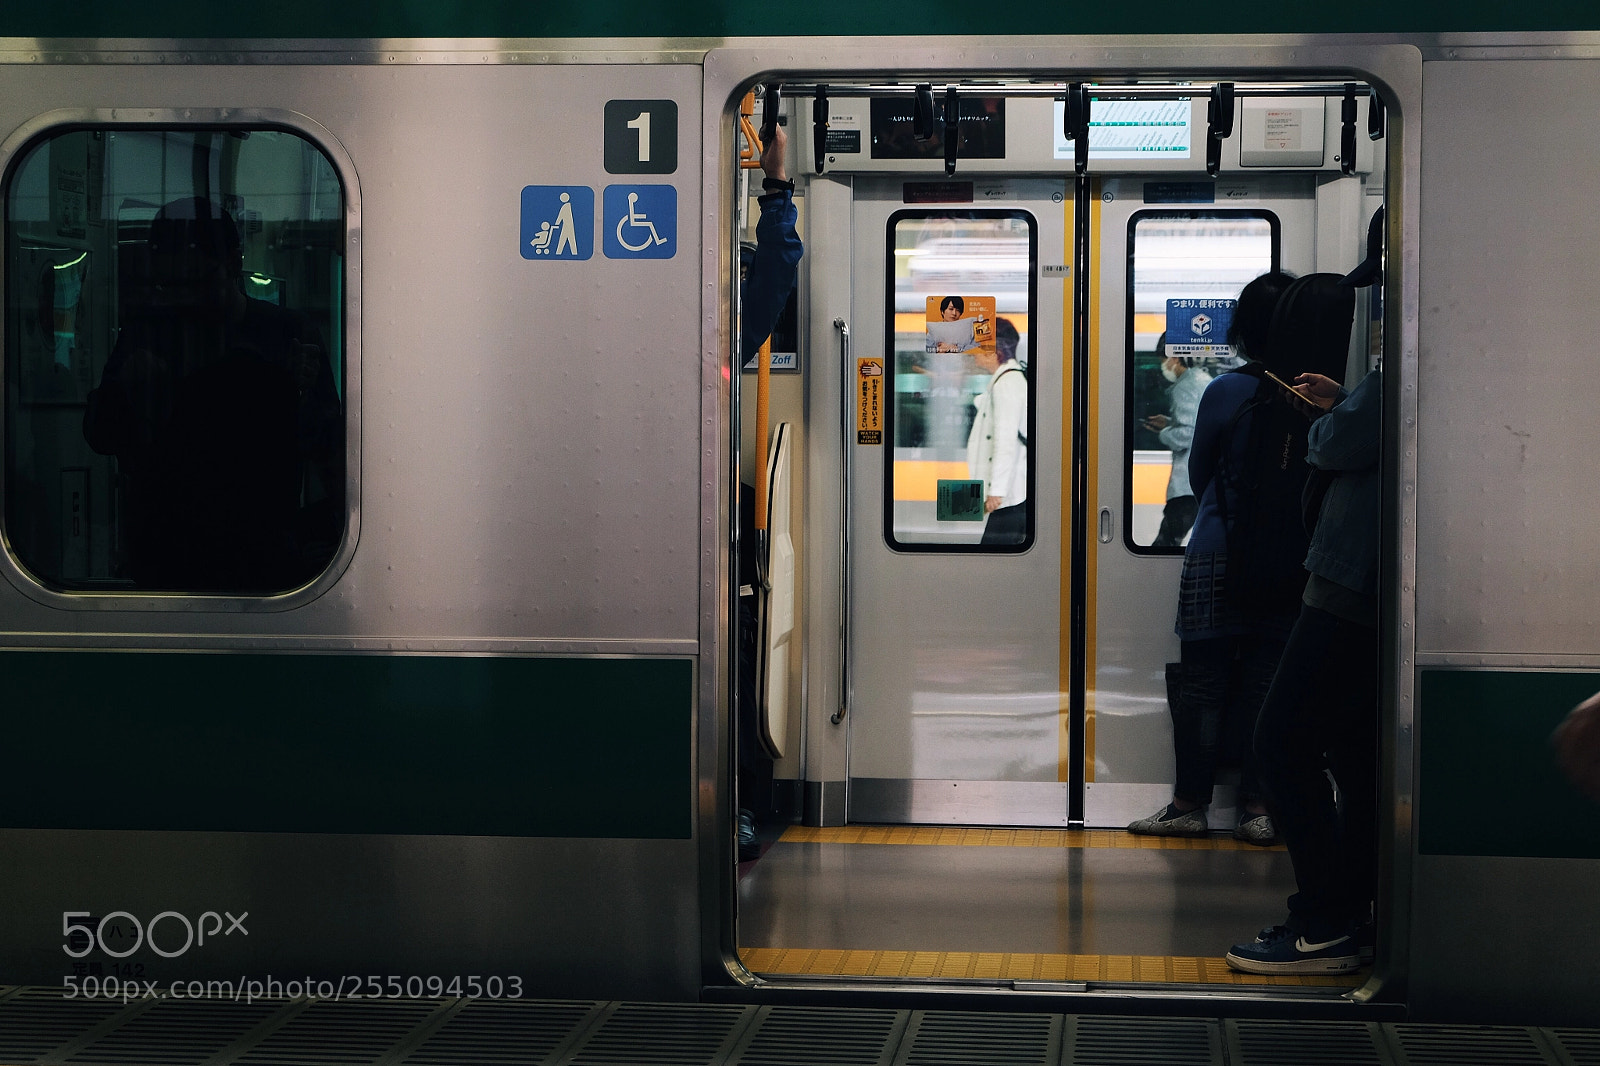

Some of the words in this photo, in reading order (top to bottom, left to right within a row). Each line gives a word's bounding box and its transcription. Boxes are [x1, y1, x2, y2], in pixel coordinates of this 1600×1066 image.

[627, 112, 650, 162] 1
[771, 355, 792, 364] Zoff
[113, 963, 146, 978] 142
